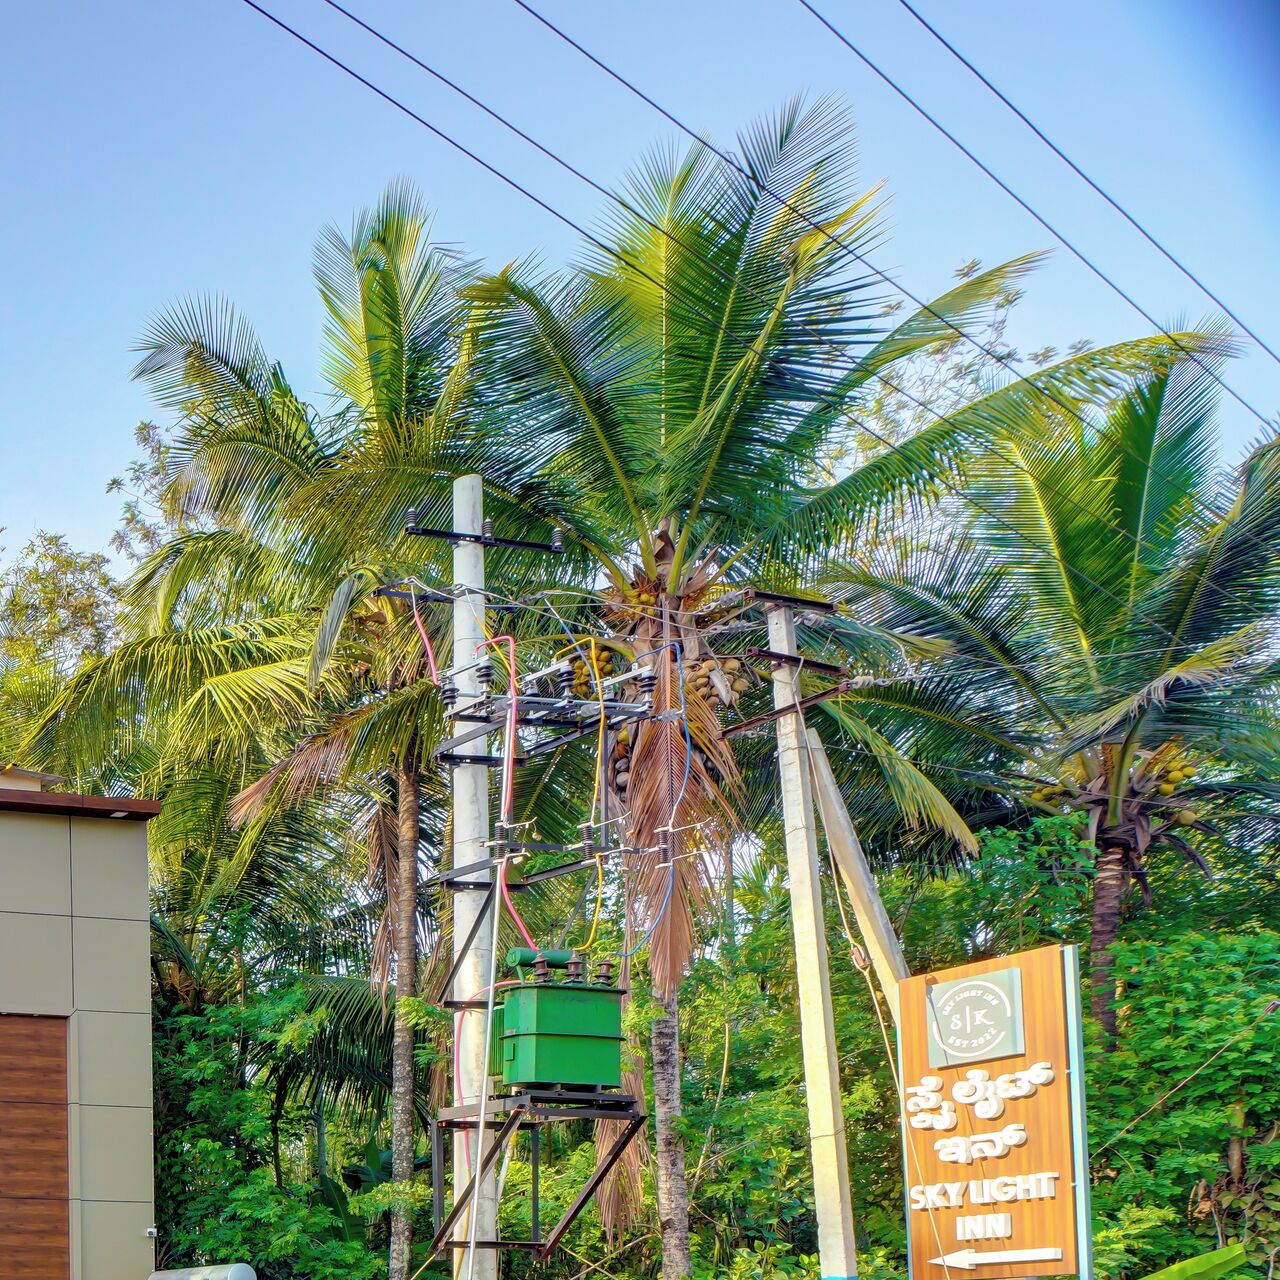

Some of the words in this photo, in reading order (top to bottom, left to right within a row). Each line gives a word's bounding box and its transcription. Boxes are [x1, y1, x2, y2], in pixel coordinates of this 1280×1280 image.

[948, 1035, 969, 1048] EST
[971, 1027, 998, 1048] 2022
[952, 1062, 1055, 1119] ಲೈಟ್
[934, 1124, 1027, 1164] ಇನ್
[910, 1182, 968, 1210] SKY
[969, 1172, 1060, 1205] LIGHT
[956, 1213, 1012, 1241] INN
